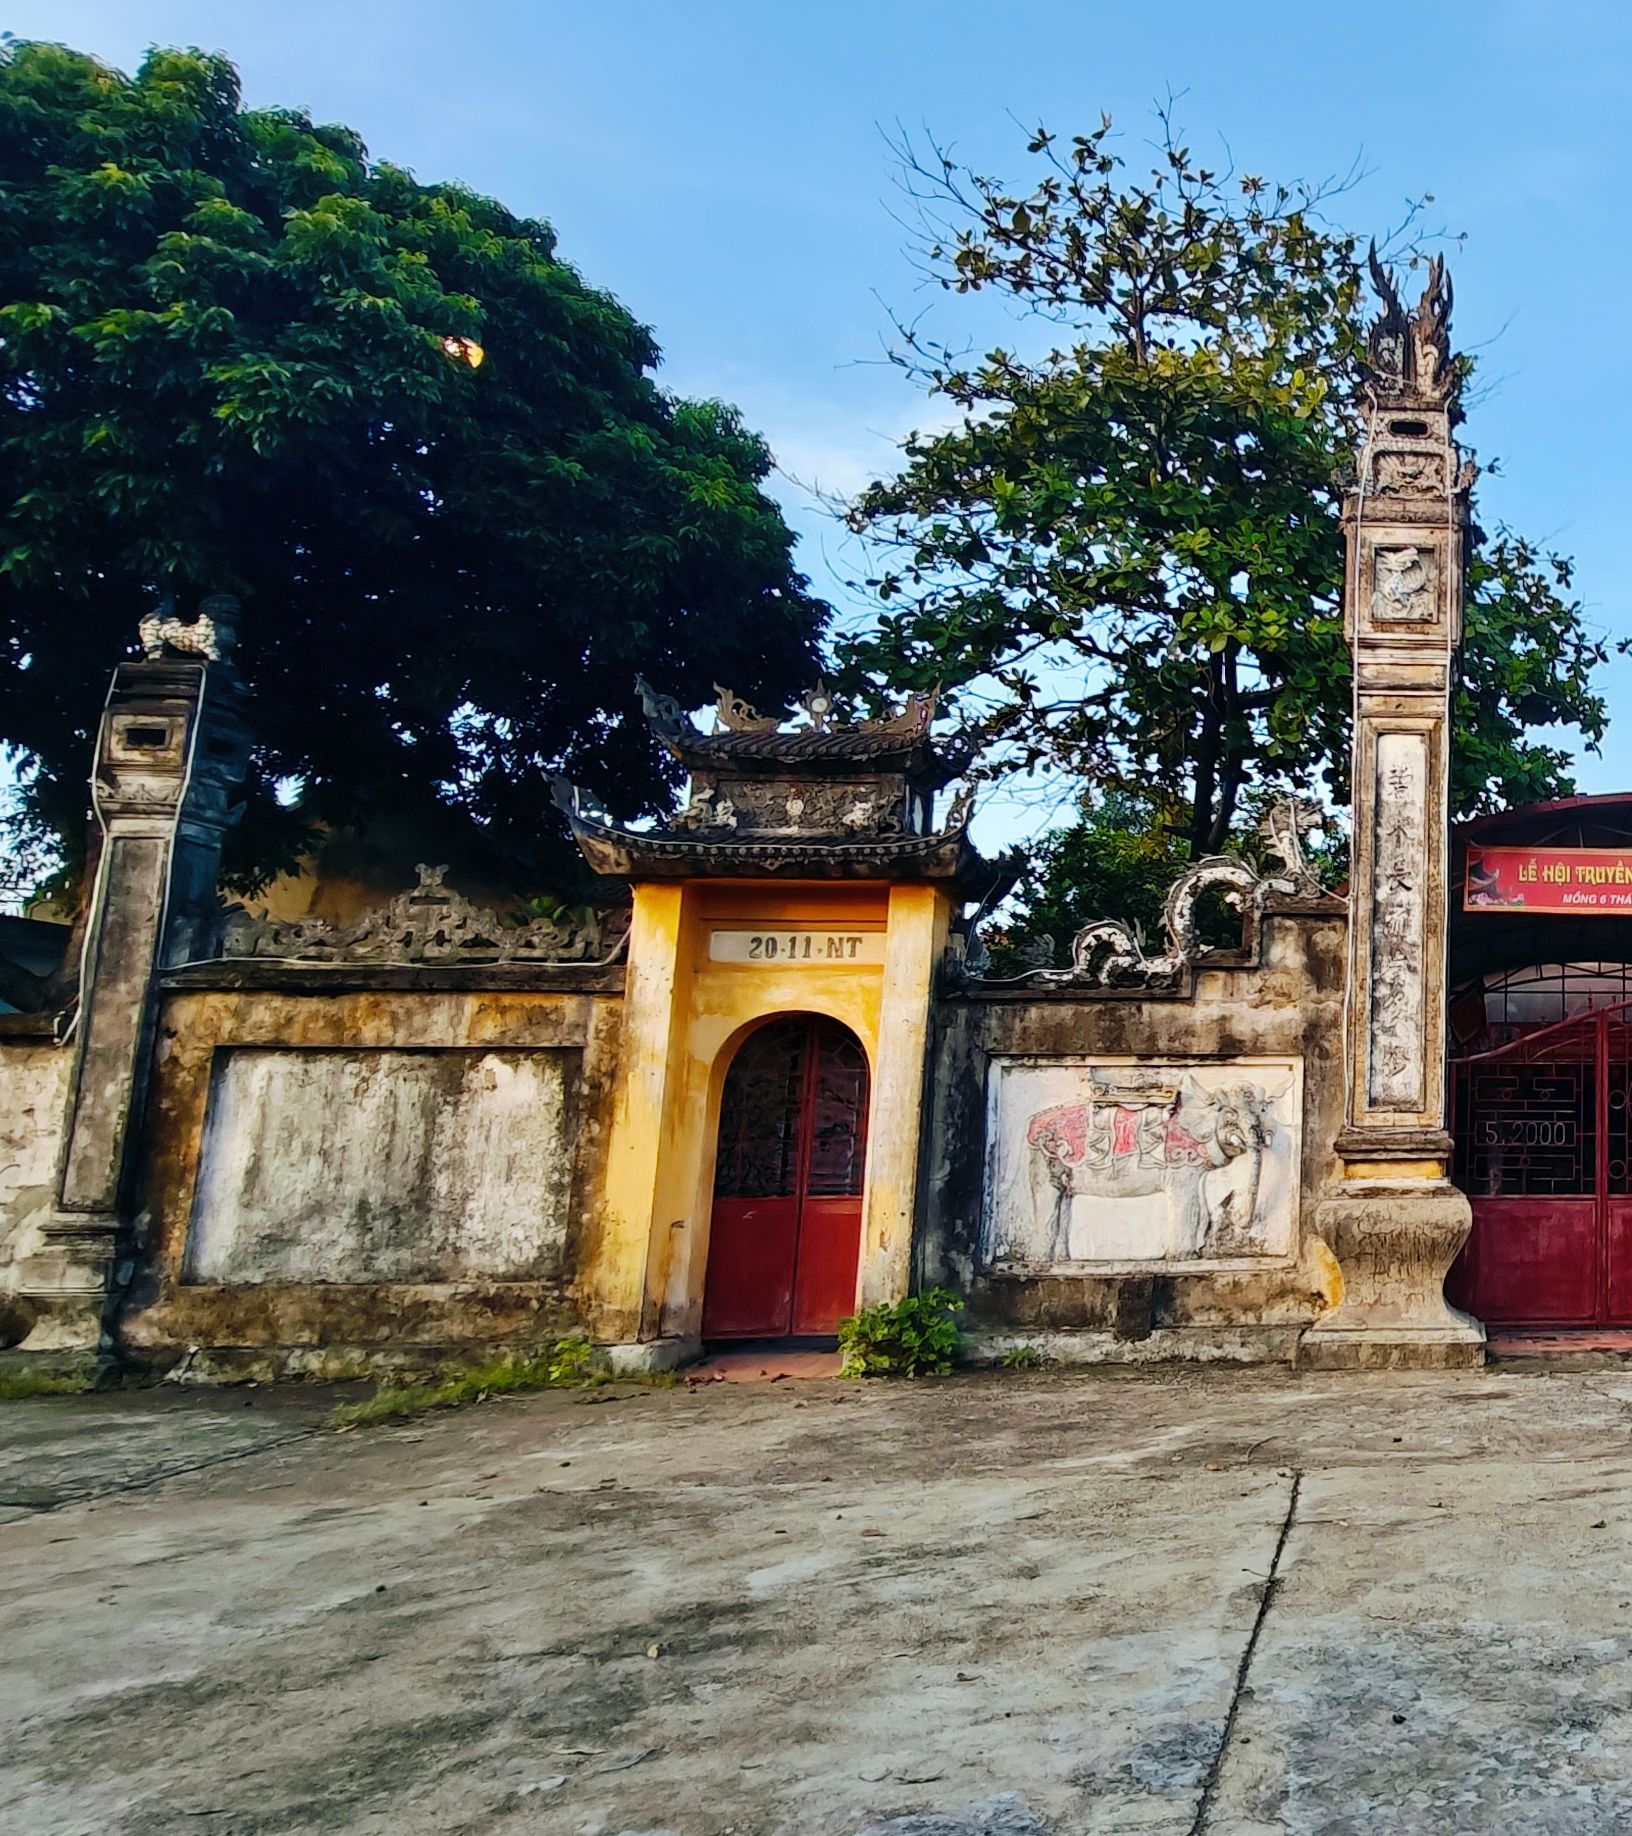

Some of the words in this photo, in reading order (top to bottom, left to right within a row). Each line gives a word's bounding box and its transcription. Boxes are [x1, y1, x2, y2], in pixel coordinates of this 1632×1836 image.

[1519, 858, 1538, 882] LỄ
[1542, 862, 1571, 886] HỘI
[1600, 894, 1607, 905] 6
